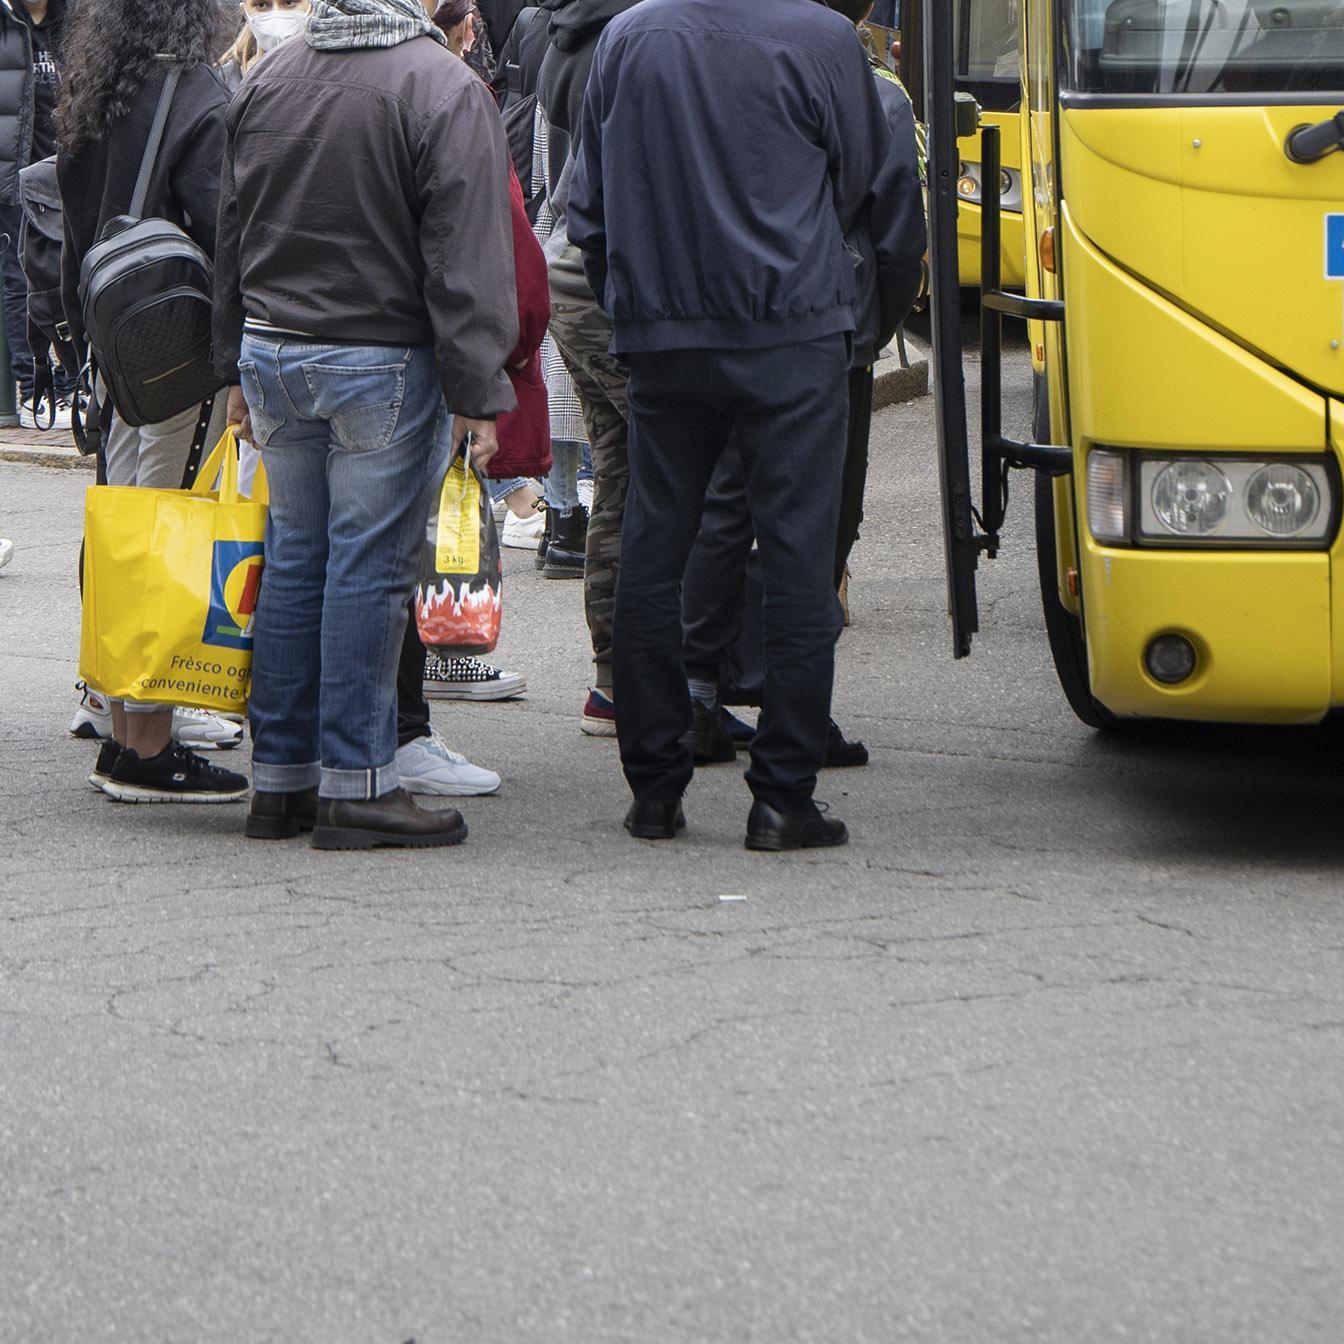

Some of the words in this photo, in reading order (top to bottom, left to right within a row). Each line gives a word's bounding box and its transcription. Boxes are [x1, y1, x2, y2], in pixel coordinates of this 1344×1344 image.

[38, 50, 53, 62] HE
[33, 61, 56, 74] RTH
[140, 677, 239, 700] conveniente
